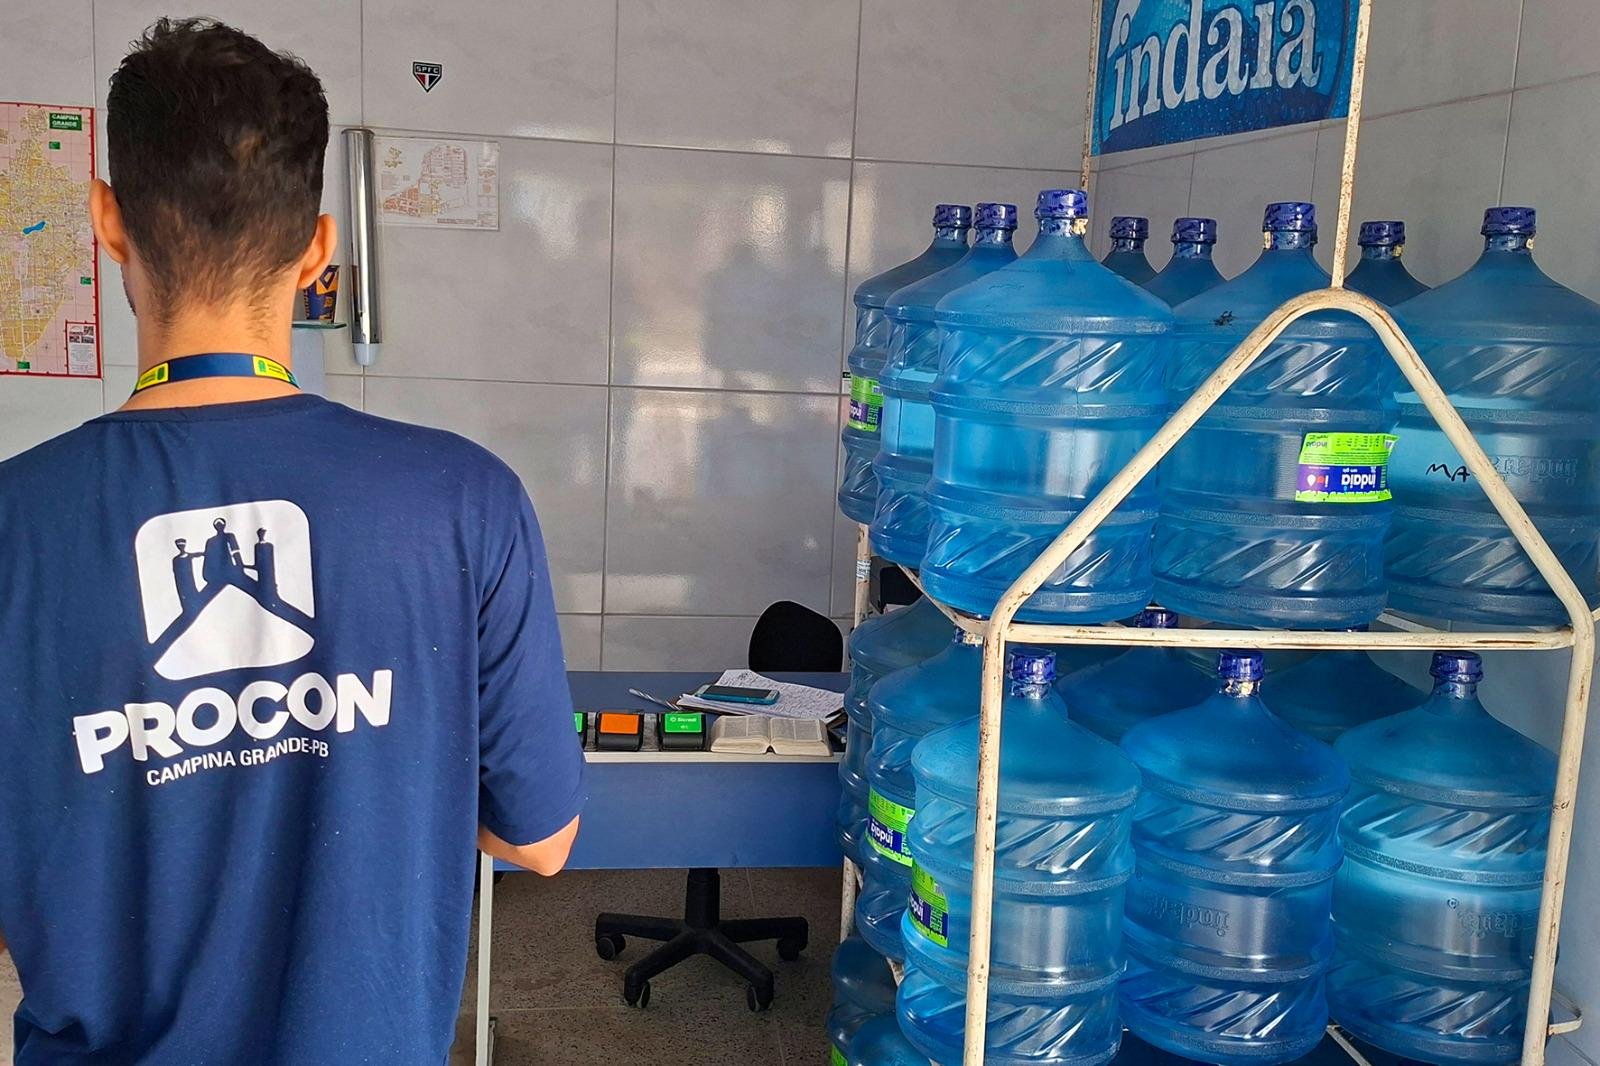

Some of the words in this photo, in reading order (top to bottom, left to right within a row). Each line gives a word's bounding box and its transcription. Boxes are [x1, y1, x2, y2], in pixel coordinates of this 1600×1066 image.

[416, 65, 439, 73] SPFC
[73, 669, 393, 775] PROCON
[146, 749, 237, 786] CAMPINA
[239, 736, 330, 767] GRANDE-PB
